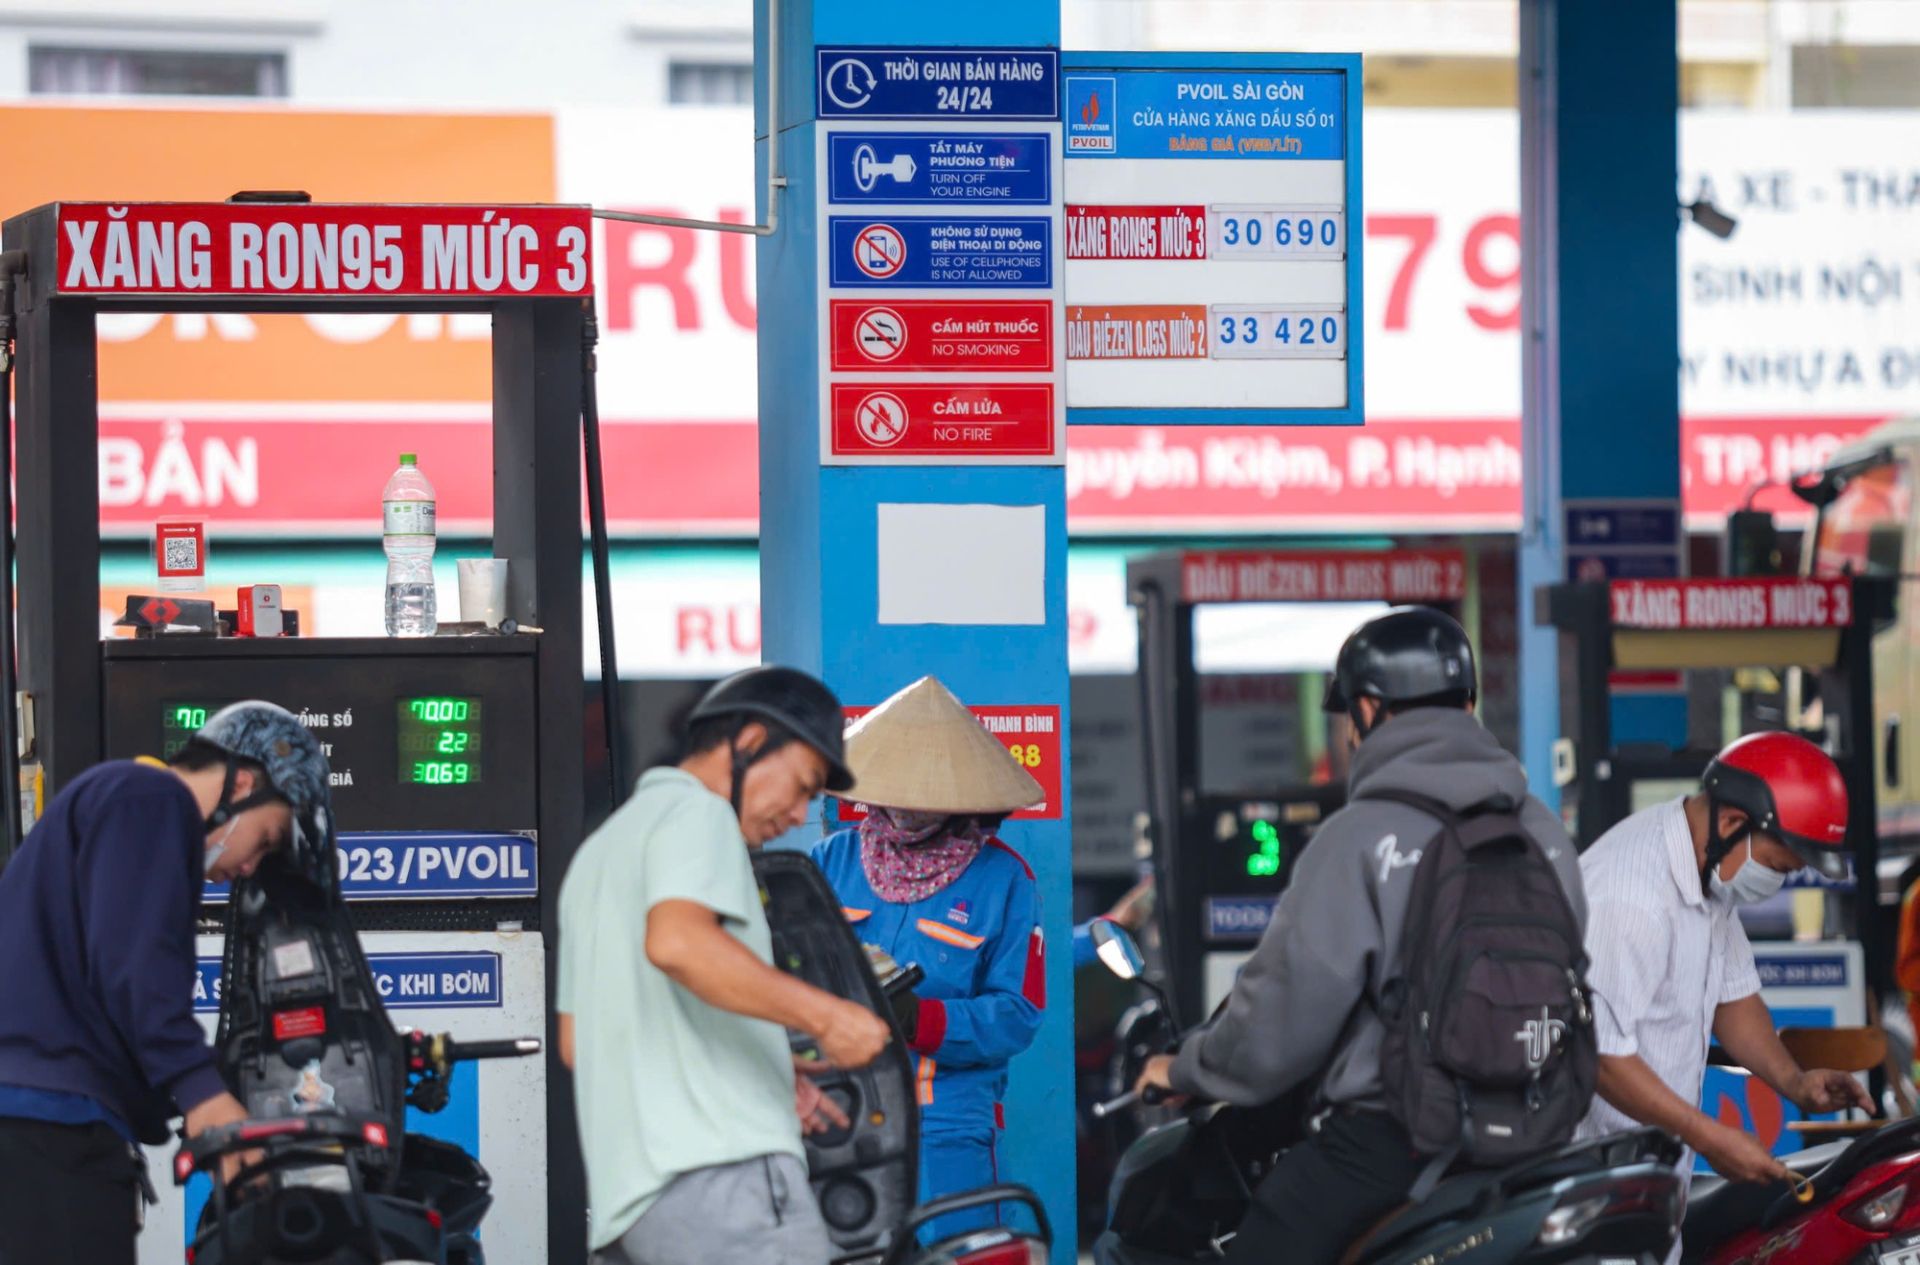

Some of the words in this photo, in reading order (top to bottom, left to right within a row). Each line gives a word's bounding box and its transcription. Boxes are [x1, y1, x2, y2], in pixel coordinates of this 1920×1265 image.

[884, 57, 919, 81] THỜI
[923, 62, 961, 81] GIAN
[965, 57, 996, 81] BÁN
[999, 57, 1044, 81] HÀNG
[936, 86, 993, 113] 24/24
[1177, 84, 1229, 101] PVOIL
[1232, 80, 1261, 101] SÀI
[1265, 80, 1304, 101] GÒN
[1132, 107, 1164, 127] CỬA
[1168, 109, 1211, 127] HÀNG
[1214, 109, 1256, 128] XĂNG
[1295, 107, 1317, 128] SỐ
[1320, 113, 1335, 128] 01
[929, 140, 952, 154] TẮT
[955, 142, 984, 154] MÁY
[1072, 137, 1110, 148] PVOIL
[1168, 133, 1208, 151] BẢNG
[1211, 134, 1235, 151] GIÁ
[929, 155, 986, 168] PHƯƠNG
[989, 154, 1015, 169] TIỆN
[930, 173, 960, 184] TURN
[963, 173, 987, 184] OFF
[930, 186, 964, 197] YOUR
[966, 186, 1011, 197] ENGINE
[931, 225, 972, 238] KHÔNG
[973, 224, 988, 238] SỬ
[991, 226, 1022, 239] DỤNG
[1067, 207, 1107, 258] XĂNG
[1110, 216, 1157, 258] RON95
[1161, 208, 1193, 258] MỨC
[1195, 216, 1205, 258] 3
[1223, 217, 1262, 246] 30
[1276, 218, 1337, 247] 690
[63, 206, 213, 289] XĂNG
[229, 221, 404, 290] RON95
[422, 210, 540, 292] MỨC
[556, 226, 588, 292] 3
[931, 239, 956, 251] ĐIỆN
[959, 240, 992, 252] THOẠI
[994, 240, 1006, 250] DI
[1009, 239, 1042, 252] ĐỘNG
[931, 257, 951, 268] USE
[953, 257, 970, 268] OF
[973, 257, 1041, 268] CELLPHONES
[931, 269, 940, 280] IS
[942, 269, 967, 280] NOT
[969, 269, 1022, 280] ALLOWED
[931, 317, 964, 334] CẤM
[966, 318, 991, 334] HÚT
[994, 317, 1039, 334] THUỐC
[1067, 307, 1091, 358] DẦU
[1135, 319, 1167, 357] 0.05S
[1169, 311, 1195, 357] MỨC
[1197, 319, 1205, 356] 2
[1220, 316, 1259, 345] 33
[1275, 317, 1338, 345] 420
[932, 344, 954, 356] NO
[957, 344, 1021, 356] SMOKING
[932, 396, 969, 415] CẤM
[974, 398, 1002, 415] LỬA
[933, 427, 959, 441] NO
[963, 427, 993, 441] FIRE
[333, 707, 353, 728] SỐ
[983, 715, 1022, 733] THANH
[1024, 713, 1054, 733] BÌNH
[328, 768, 354, 786] GIÁ
[400, 973, 436, 996] KHI
[442, 970, 490, 995] BƠM
